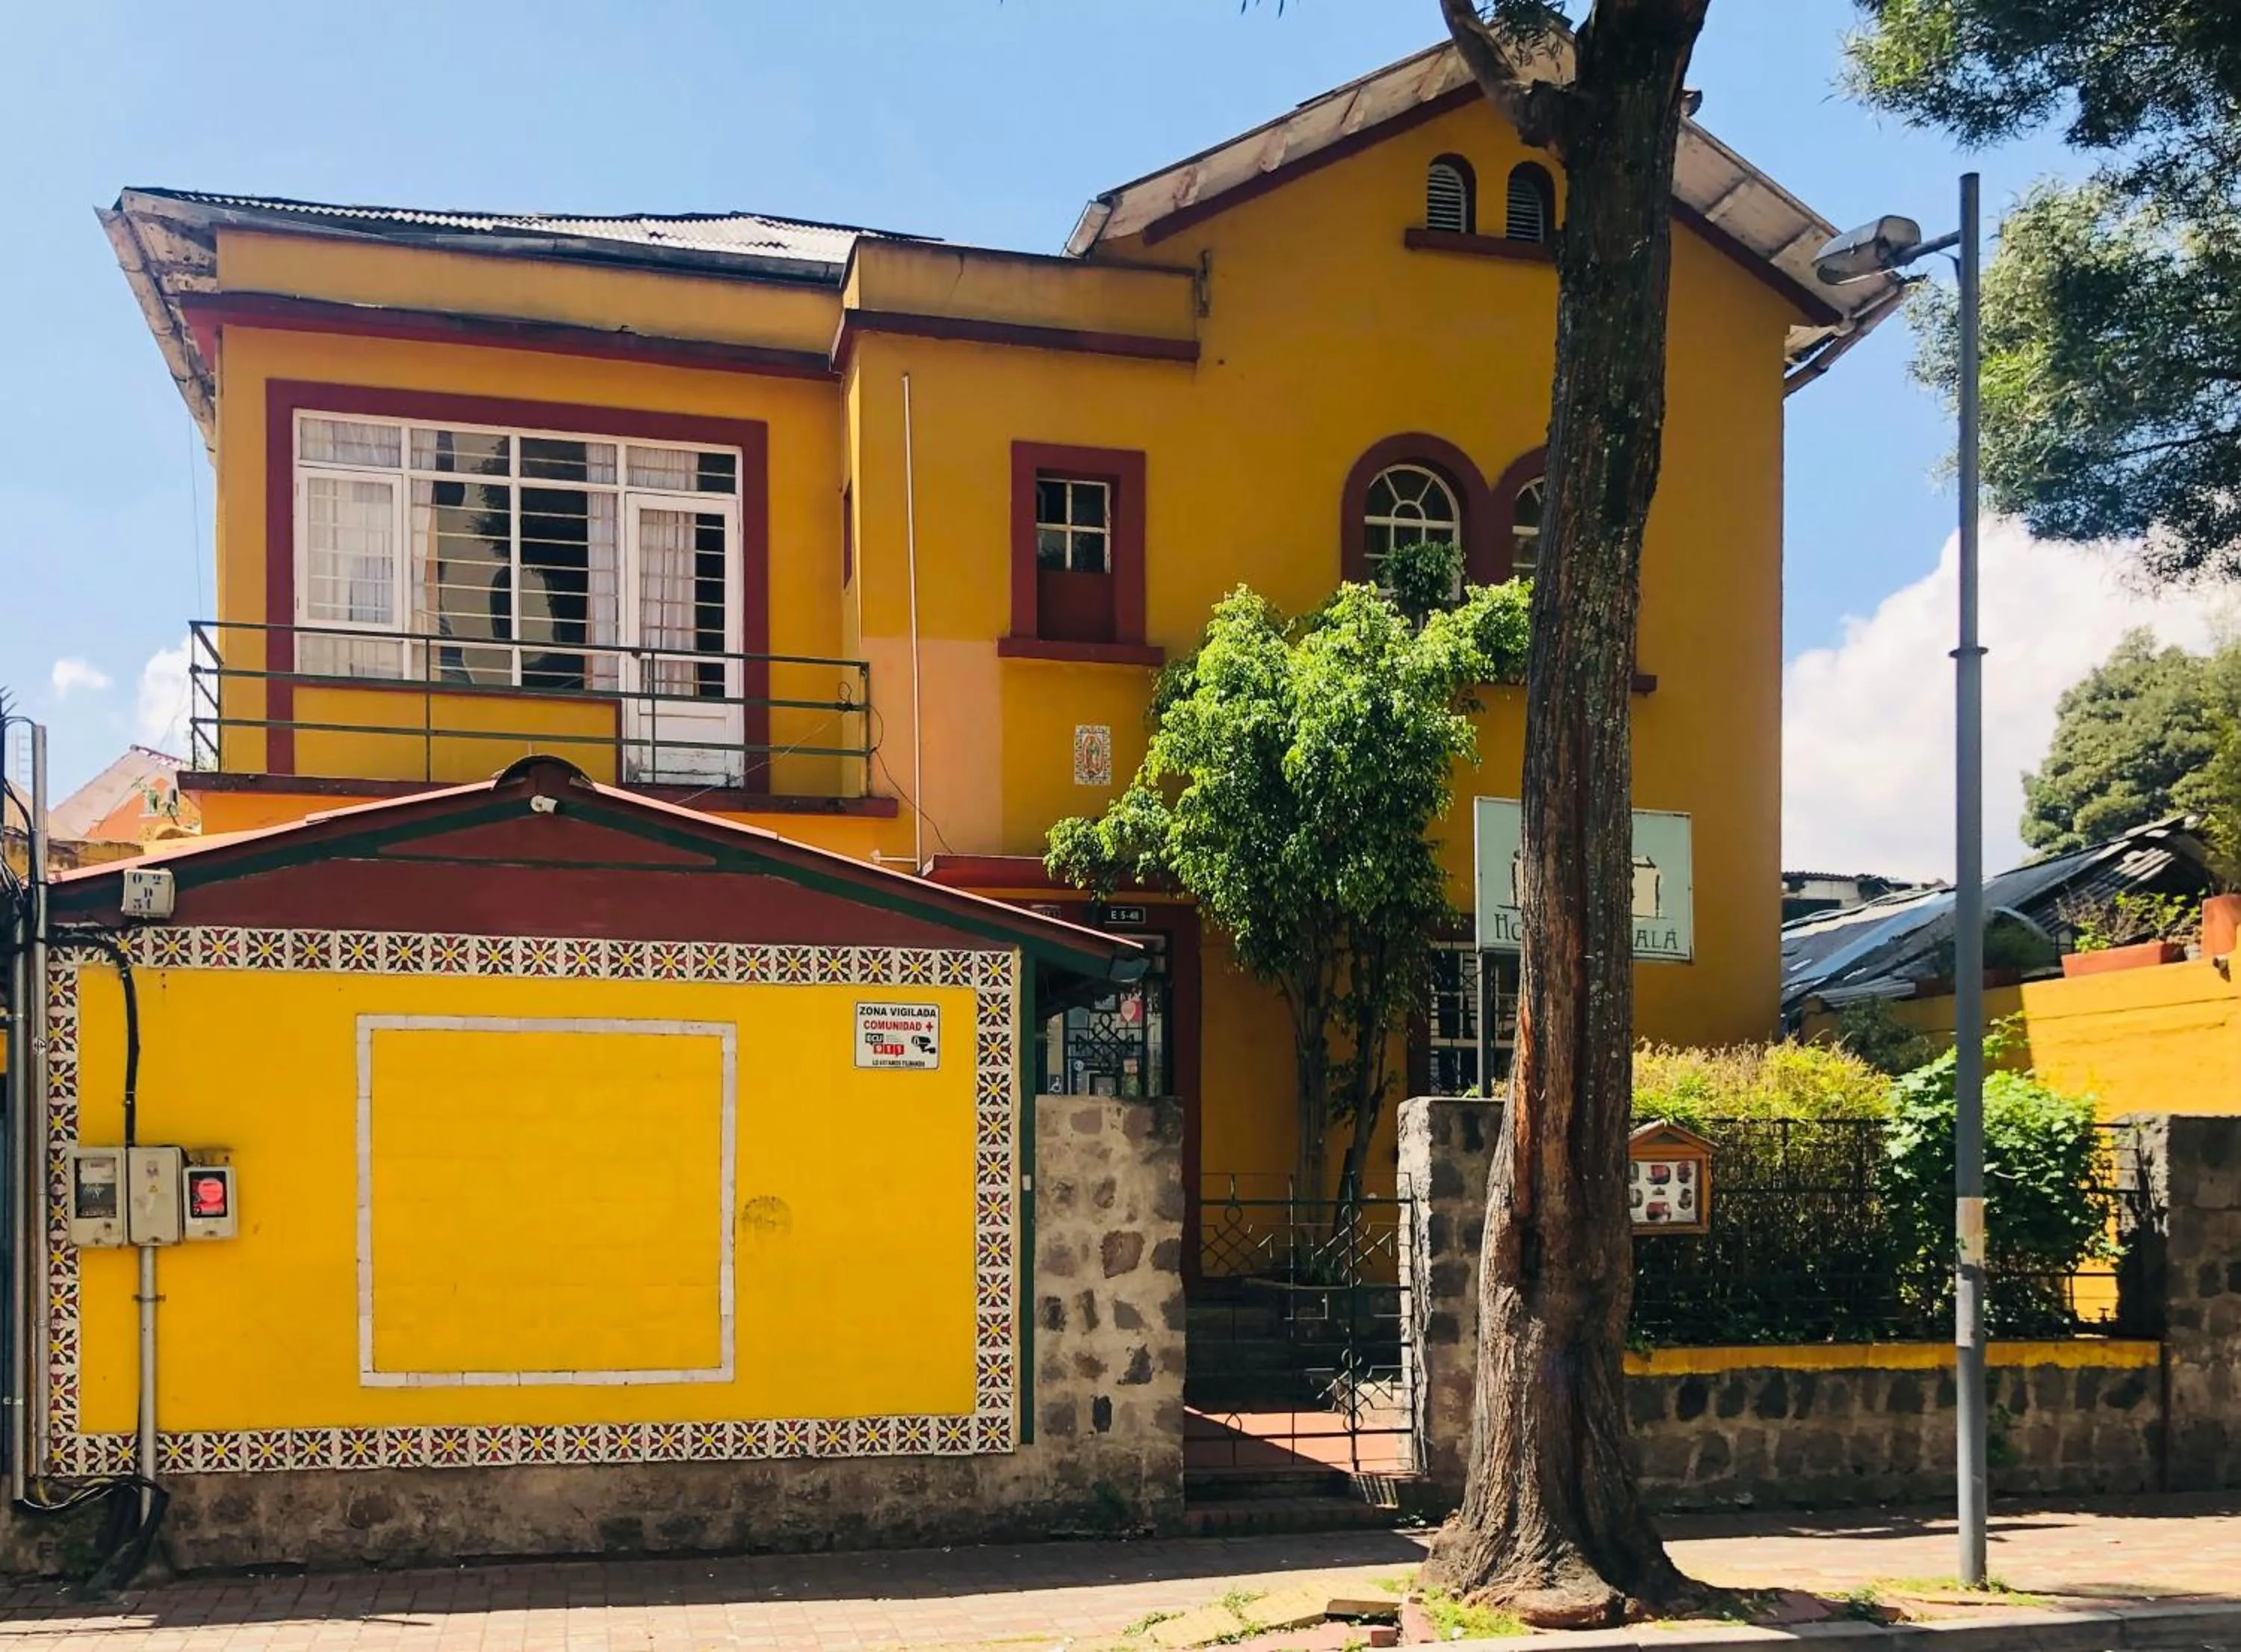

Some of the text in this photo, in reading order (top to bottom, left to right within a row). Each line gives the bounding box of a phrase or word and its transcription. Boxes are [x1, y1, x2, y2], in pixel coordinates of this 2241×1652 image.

[1634, 928, 1678, 949] ALÁ
[859, 1006, 936, 1017] ZONA VIGILADA
[864, 1020, 922, 1031] COMUNIDAD
